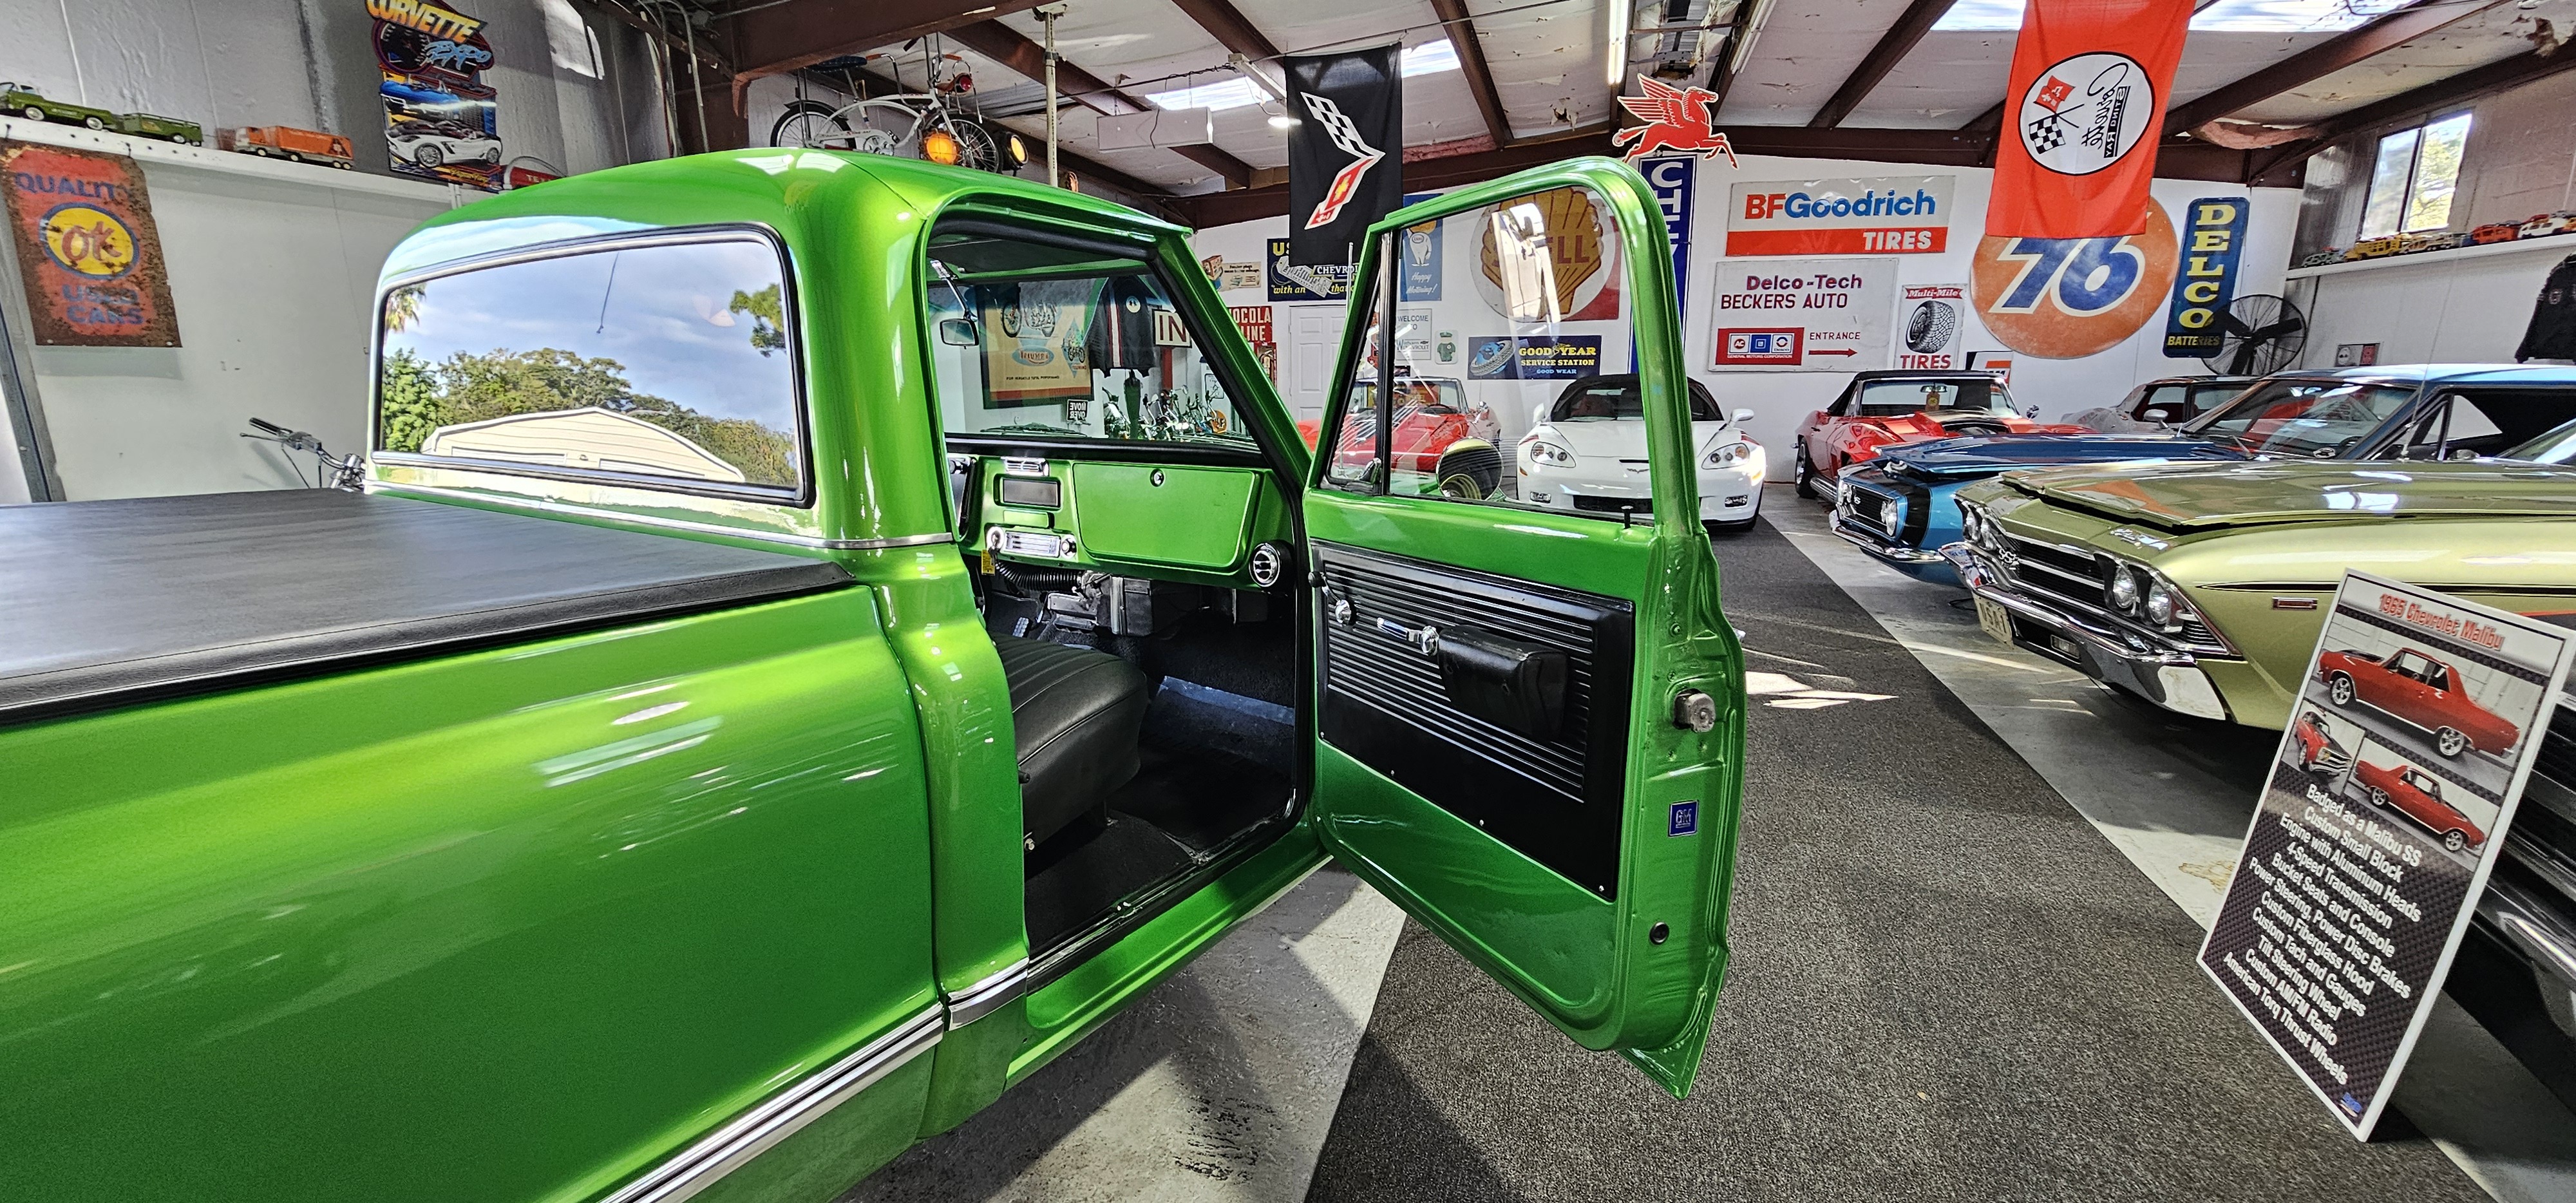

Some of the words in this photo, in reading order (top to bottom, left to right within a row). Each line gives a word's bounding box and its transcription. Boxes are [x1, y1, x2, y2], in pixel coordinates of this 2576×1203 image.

[366, 0, 482, 43] CORVETTE
[14, 172, 129, 200] QUALIT
[1745, 189, 1936, 219] BFGoodrich
[1864, 231, 1932, 250] TIRES
[1412, 272, 1432, 283] Happy
[1989, 236, 2146, 317] 76
[2179, 205, 2236, 328] DELCO
[66, 305, 143, 325] CARS
[1229, 307, 1271, 323] OCOLA
[1721, 294, 1795, 309] BECKERS
[1803, 293, 1848, 308] AUTO
[1908, 289, 1958, 298] Multi-Mile
[1160, 315, 1186, 342] IN
[1810, 332, 1861, 340] ENTRANCE
[2166, 336, 2221, 346] BATTERIES
[1900, 354, 1951, 369] TIRES
[2379, 593, 2407, 618] 1965
[2406, 603, 2460, 636] Chevrolet
[2460, 620, 2505, 651] Malibu
[1676, 809, 1692, 824] GM
[2306, 784, 2345, 817] Badged
[2342, 810, 2357, 826] as
[2356, 819, 2366, 831] a
[2364, 820, 2403, 856] Malibu
[2401, 844, 2422, 867] SS
[2279, 812, 2311, 843] Engine
[2311, 838, 2333, 858] with
[2330, 849, 2384, 896] Aluminum
[2383, 885, 2422, 922] Heads
[2304, 806, 2341, 840] Custom
[2340, 830, 2372, 860] Small
[2369, 849, 2404, 883] Block
[2271, 852, 2304, 886] Bucket
[2302, 876, 2330, 906] Seats
[2329, 900, 2351, 923] and
[2349, 913, 2395, 958] Console
[2287, 841, 2325, 877] 4-Speed
[2324, 867, 2392, 929] Transmission
[2249, 857, 2275, 886] Power
[2274, 878, 2312, 921] Steering,
[2313, 909, 2346, 944] Power
[2344, 934, 2370, 965] Disc
[2369, 955, 2411, 999] Brakes
[2261, 891, 2295, 927] Custom
[2293, 918, 2343, 969] Fiberglass
[2342, 960, 2375, 996] Hood
[2253, 907, 2285, 943] Custom
[2285, 934, 2307, 964] Tach
[2306, 958, 2327, 981] and
[2325, 973, 2367, 1017] Gauges
[2258, 934, 2274, 958] Tilt
[2271, 949, 2309, 994] Steering
[2308, 983, 2342, 1021] Wheel
[2223, 951, 2261, 996] American
[2260, 987, 2281, 1019] Torq
[2280, 1007, 2311, 1047] Thrust
[2309, 1037, 2348, 1085] Wheels
[2246, 948, 2278, 987] Custom
[2306, 1008, 2338, 1046] Radio
